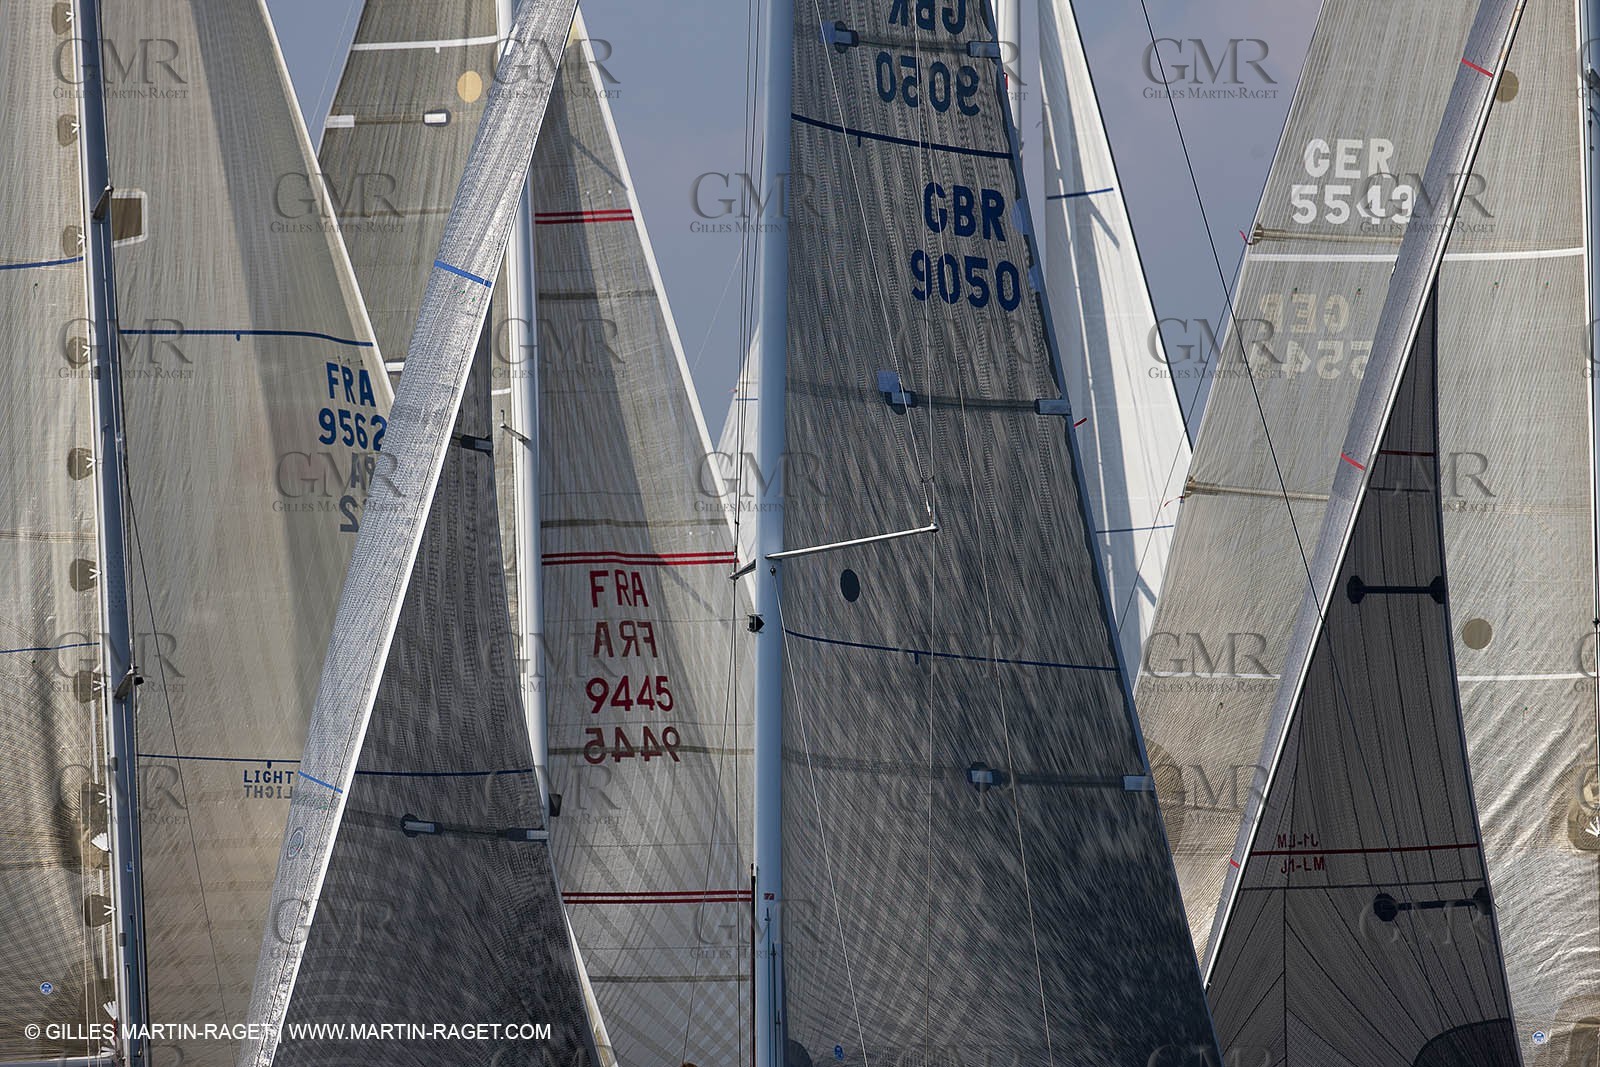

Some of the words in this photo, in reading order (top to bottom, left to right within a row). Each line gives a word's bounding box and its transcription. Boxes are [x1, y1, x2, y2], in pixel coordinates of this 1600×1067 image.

[1304, 138, 1395, 179] GER
[924, 182, 1007, 242] GBR
[910, 249, 1021, 312] 9050
[326, 361, 377, 407] FRA
[318, 407, 388, 451] 9562
[589, 569, 649, 609] FRA
[585, 675, 674, 714] 9445
[243, 769, 294, 785] LIGHT
